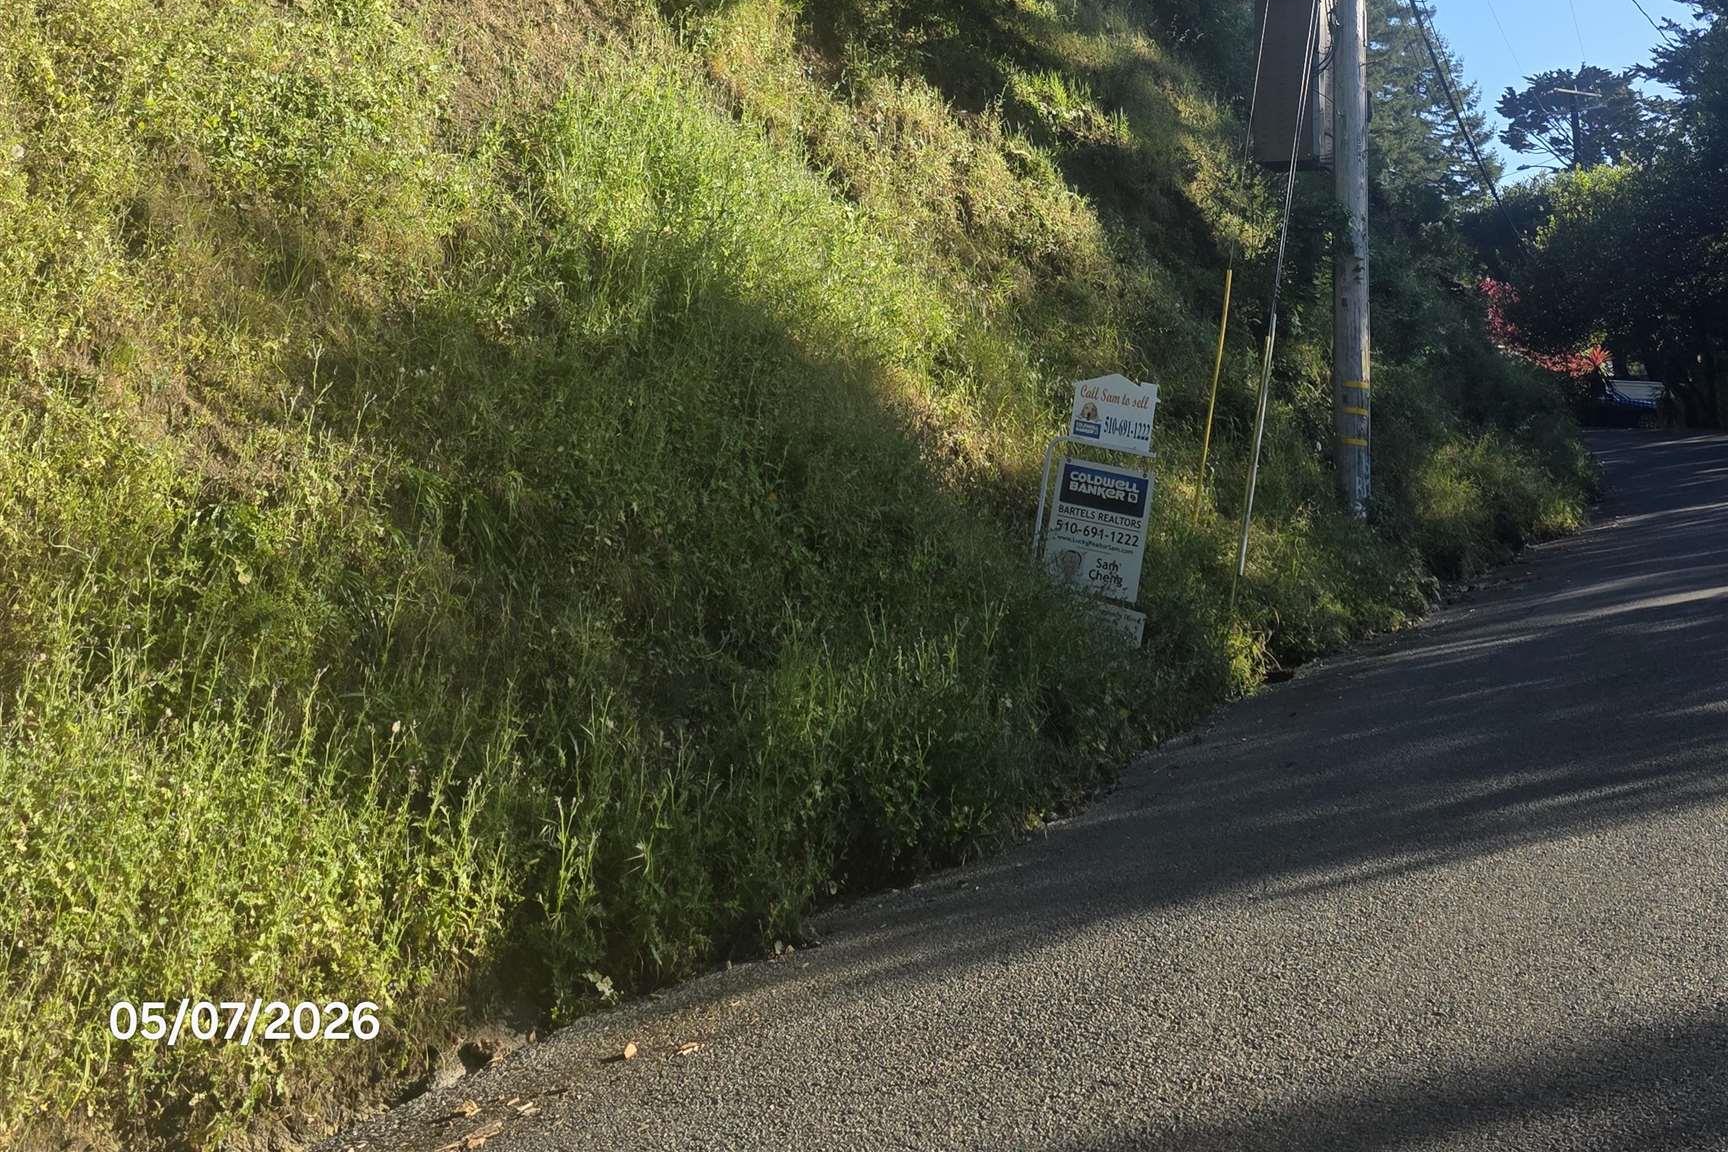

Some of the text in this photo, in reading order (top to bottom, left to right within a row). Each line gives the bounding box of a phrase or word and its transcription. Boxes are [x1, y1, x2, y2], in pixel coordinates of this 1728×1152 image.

[1080, 384, 1150, 409] Call Sam to sell
[1103, 415, 1151, 441] 510-691-1222
[1058, 504, 1142, 529] BARTELS REALTORS
[1056, 519, 1140, 547] 510-691-1222
[1096, 558, 1119, 572] Sam
